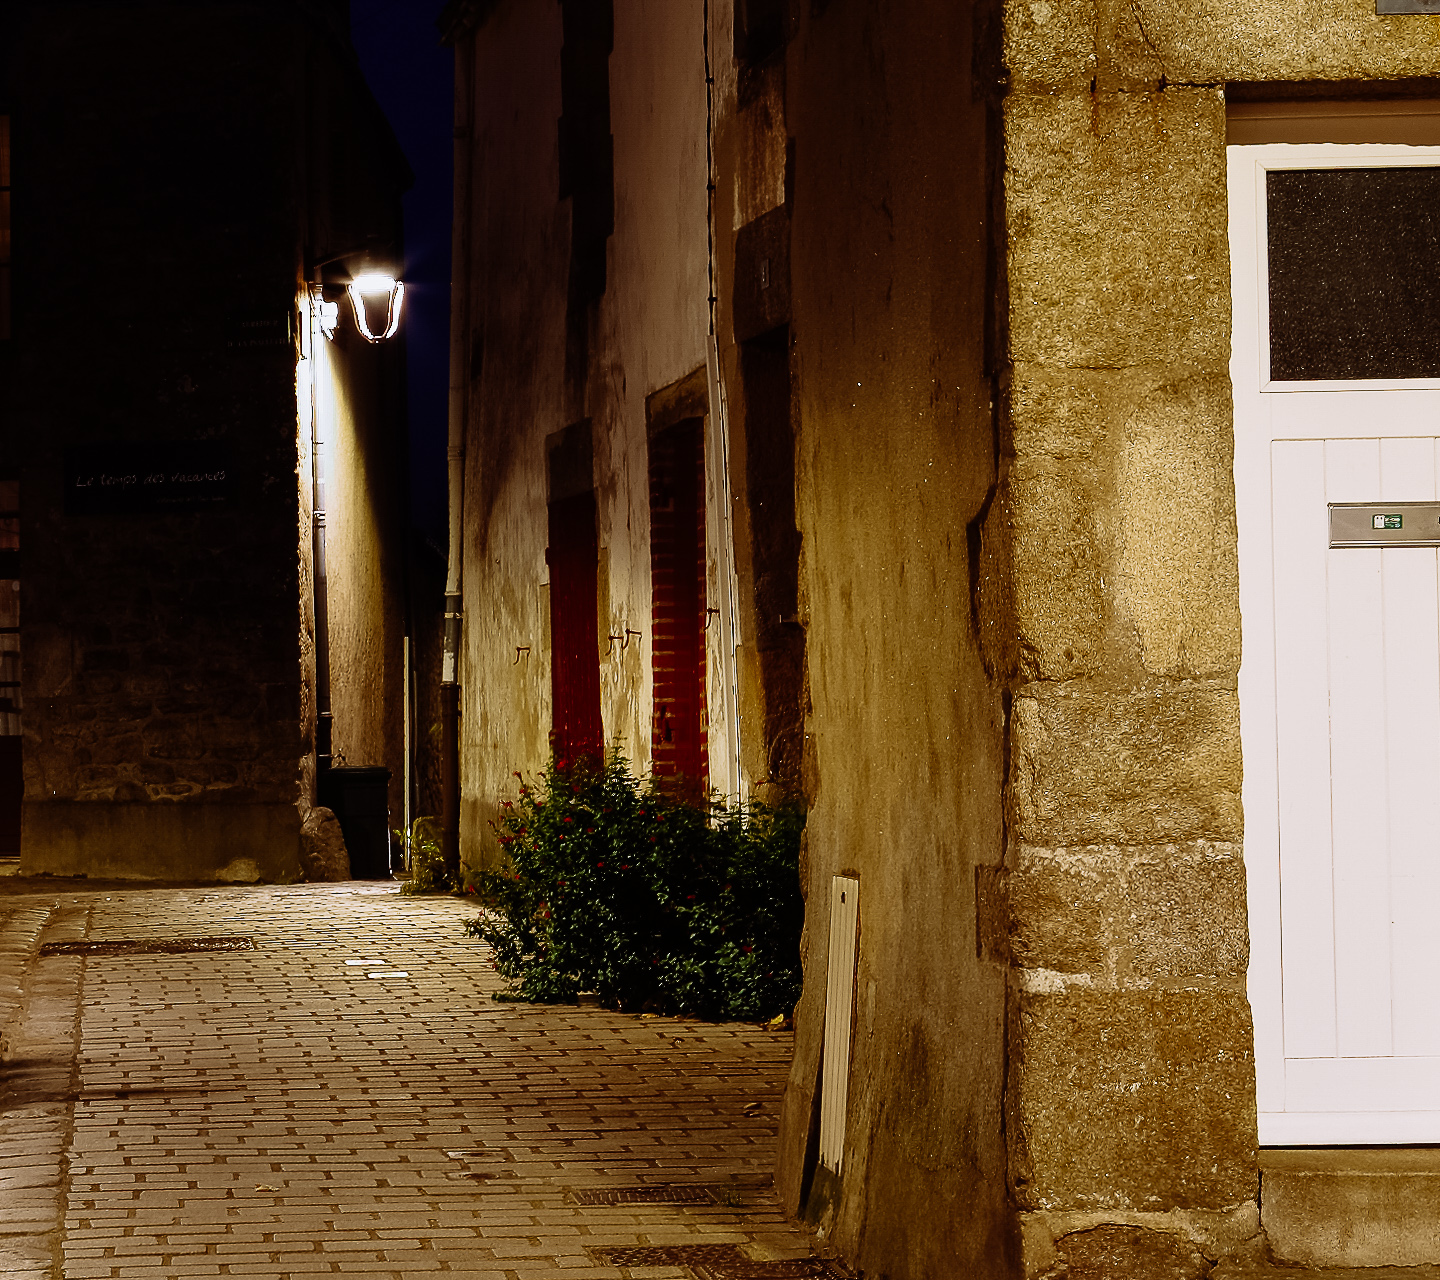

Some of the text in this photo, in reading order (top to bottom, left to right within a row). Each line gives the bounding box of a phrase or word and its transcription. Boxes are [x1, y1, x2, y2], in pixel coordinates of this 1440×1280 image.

[76, 469, 226, 490] Le temps des vacances
